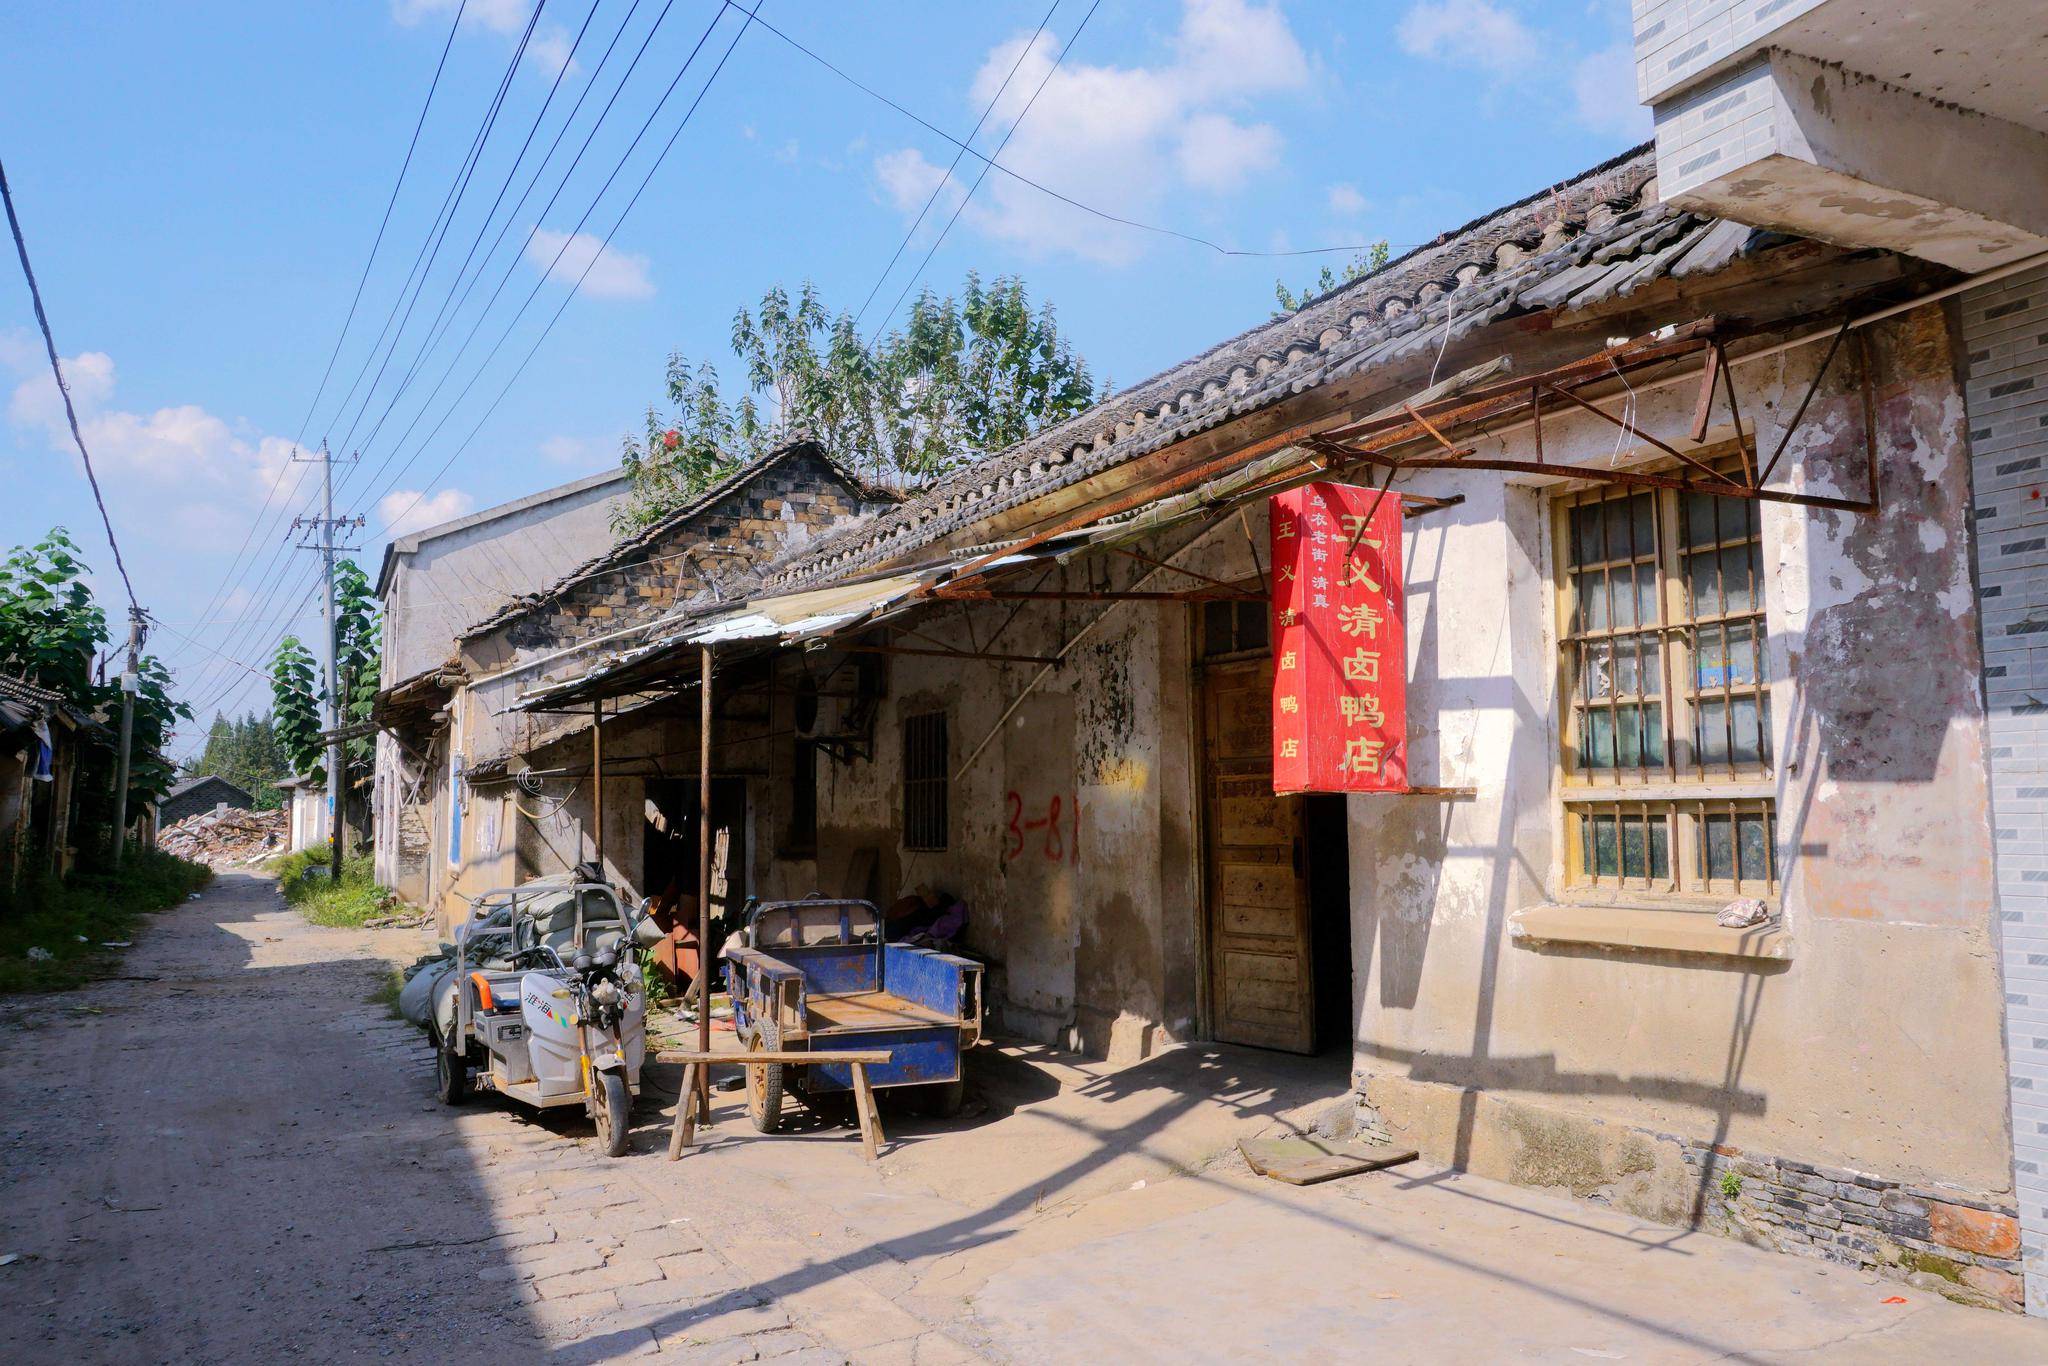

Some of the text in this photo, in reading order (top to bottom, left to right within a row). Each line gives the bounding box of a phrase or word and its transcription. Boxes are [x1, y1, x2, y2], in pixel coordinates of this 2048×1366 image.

[1276, 520, 1299, 758] 王义清卤鸭店
[1335, 513, 1384, 774] 王义清卤鸭店
